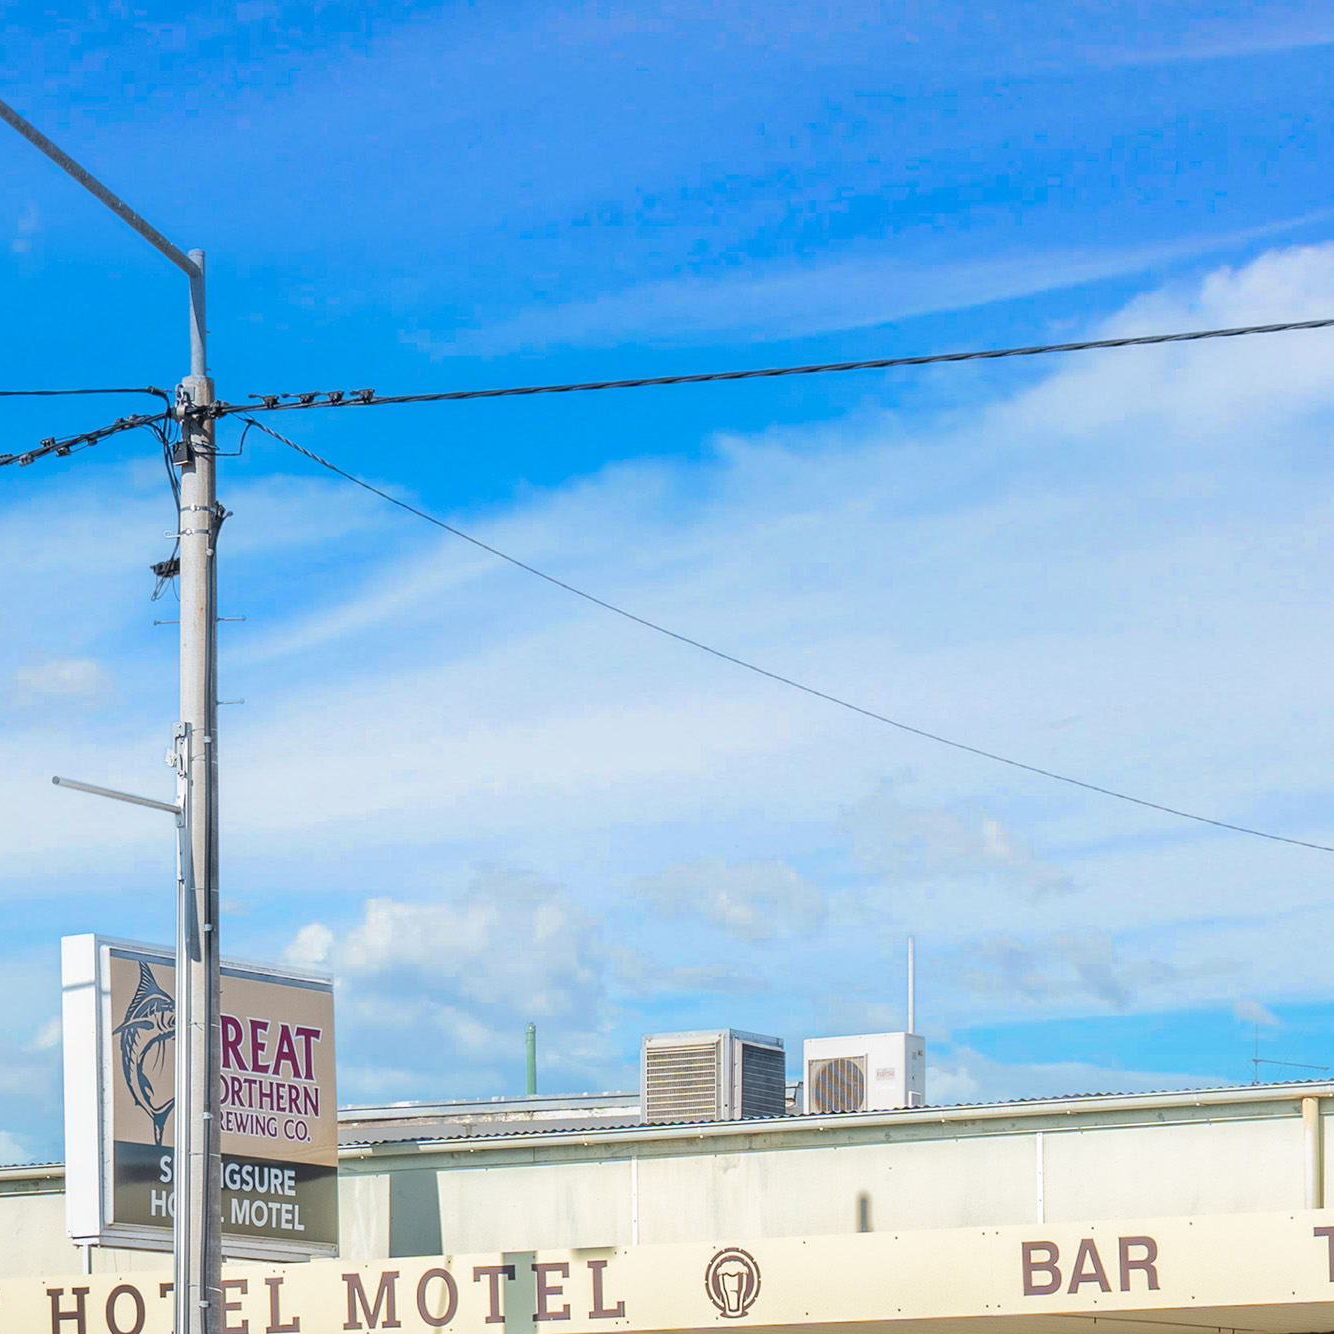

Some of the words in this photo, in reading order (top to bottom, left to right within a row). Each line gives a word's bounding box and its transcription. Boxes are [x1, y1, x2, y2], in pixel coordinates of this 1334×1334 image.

[220, 1014, 321, 1081] REAT
[220, 1074, 319, 1117] ORTHERN
[220, 1110, 278, 1138] REWING
[284, 1119, 311, 1142] CO.
[159, 1155, 296, 1197] SGSURE
[231, 1198, 305, 1231] MOTEL
[1020, 1235, 1161, 1297] BAR
[341, 1260, 626, 1332] MOTEL
